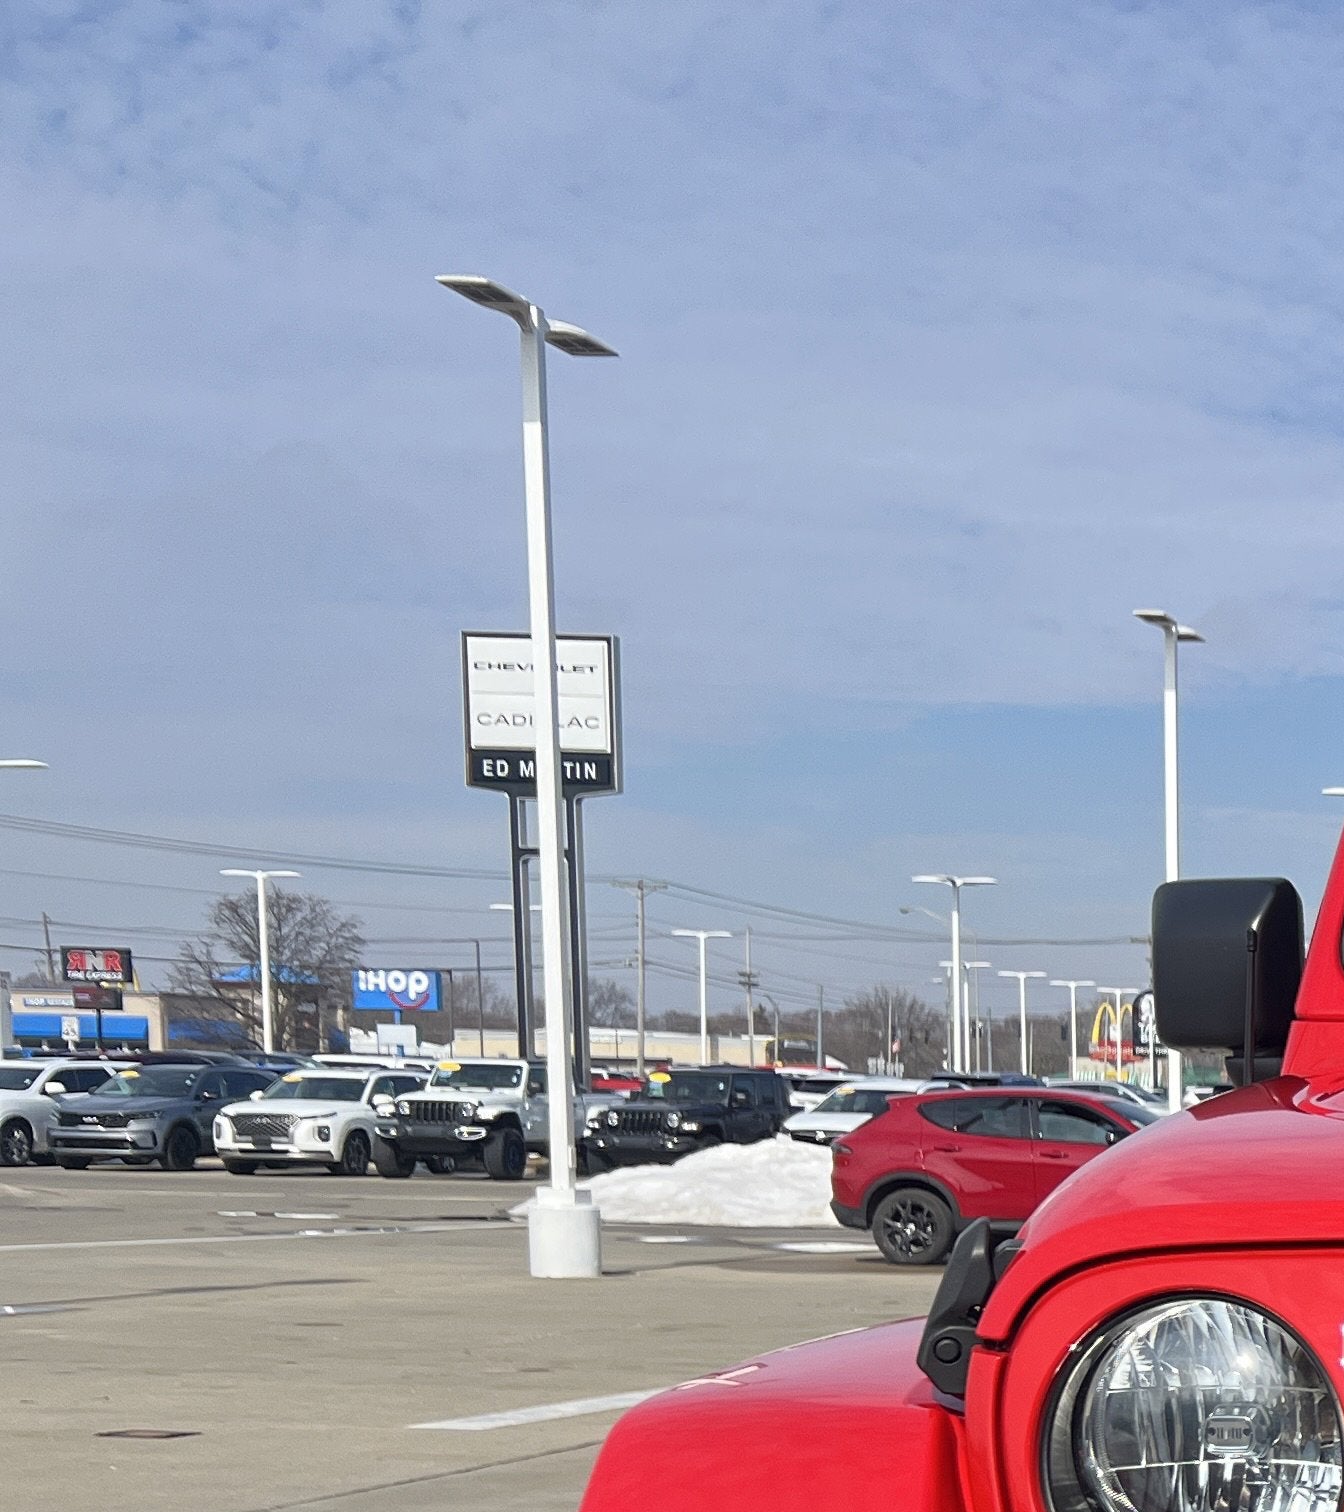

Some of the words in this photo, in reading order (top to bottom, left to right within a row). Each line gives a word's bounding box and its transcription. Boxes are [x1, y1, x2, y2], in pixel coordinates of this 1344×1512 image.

[473, 660, 599, 674] CHEVLET
[476, 712, 600, 730] CADIAC
[483, 758, 509, 777] ED
[519, 759, 597, 781] MTIN
[358, 969, 429, 1001] IHOP
